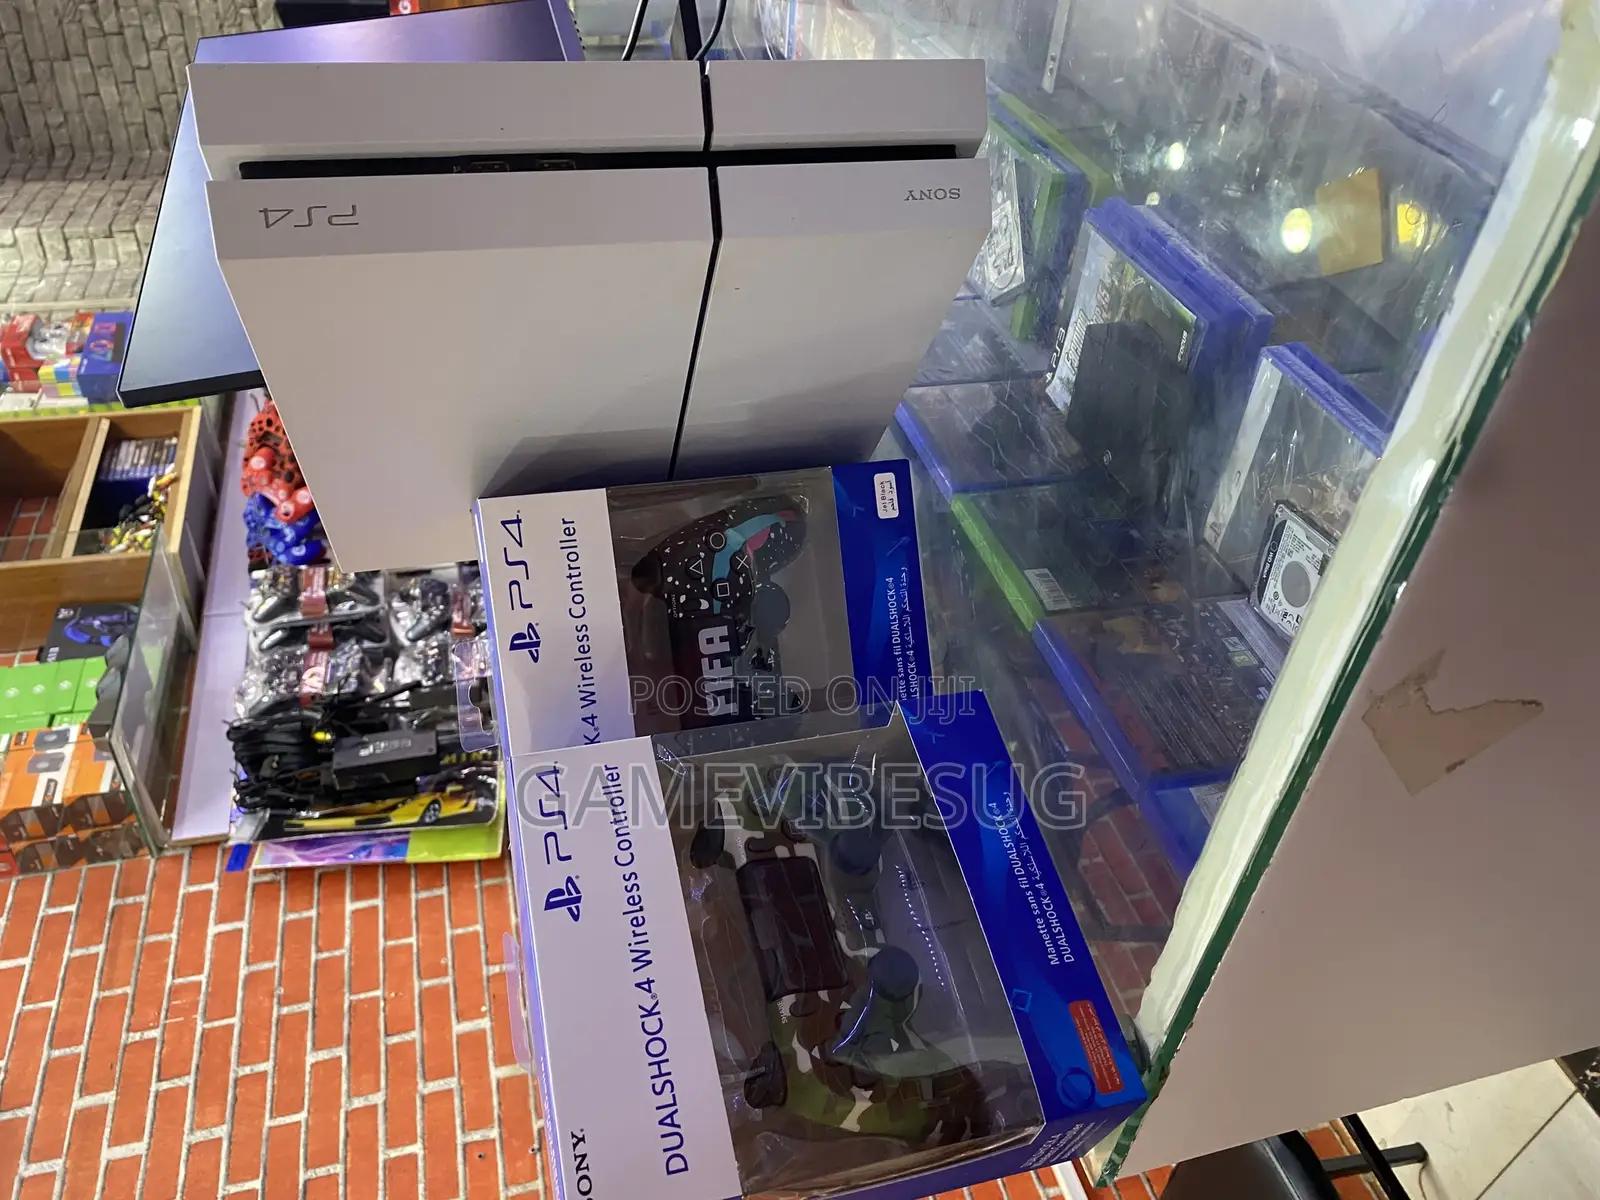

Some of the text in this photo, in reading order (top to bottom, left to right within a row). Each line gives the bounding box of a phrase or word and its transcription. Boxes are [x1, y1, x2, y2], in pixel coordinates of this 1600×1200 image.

[258, 205, 360, 229] PS4
[904, 188, 961, 201] SONY
[1051, 327, 1066, 368] PS3
[500, 514, 533, 611] PS4
[559, 518, 587, 619] Controller
[1262, 551, 1274, 579] WD Black
[574, 624, 597, 709] Wireless
[698, 625, 739, 717] FIFA
[893, 646, 902, 655] fil
[896, 657, 905, 677] sans
[535, 765, 573, 865] PS4
[602, 765, 635, 867] Controller
[1018, 877, 1030, 889] fil
[1025, 891, 1041, 915] sans
[622, 871, 653, 973] Wireless
[1036, 917, 1060, 966] Manette
[571, 1131, 593, 1200] ONY
